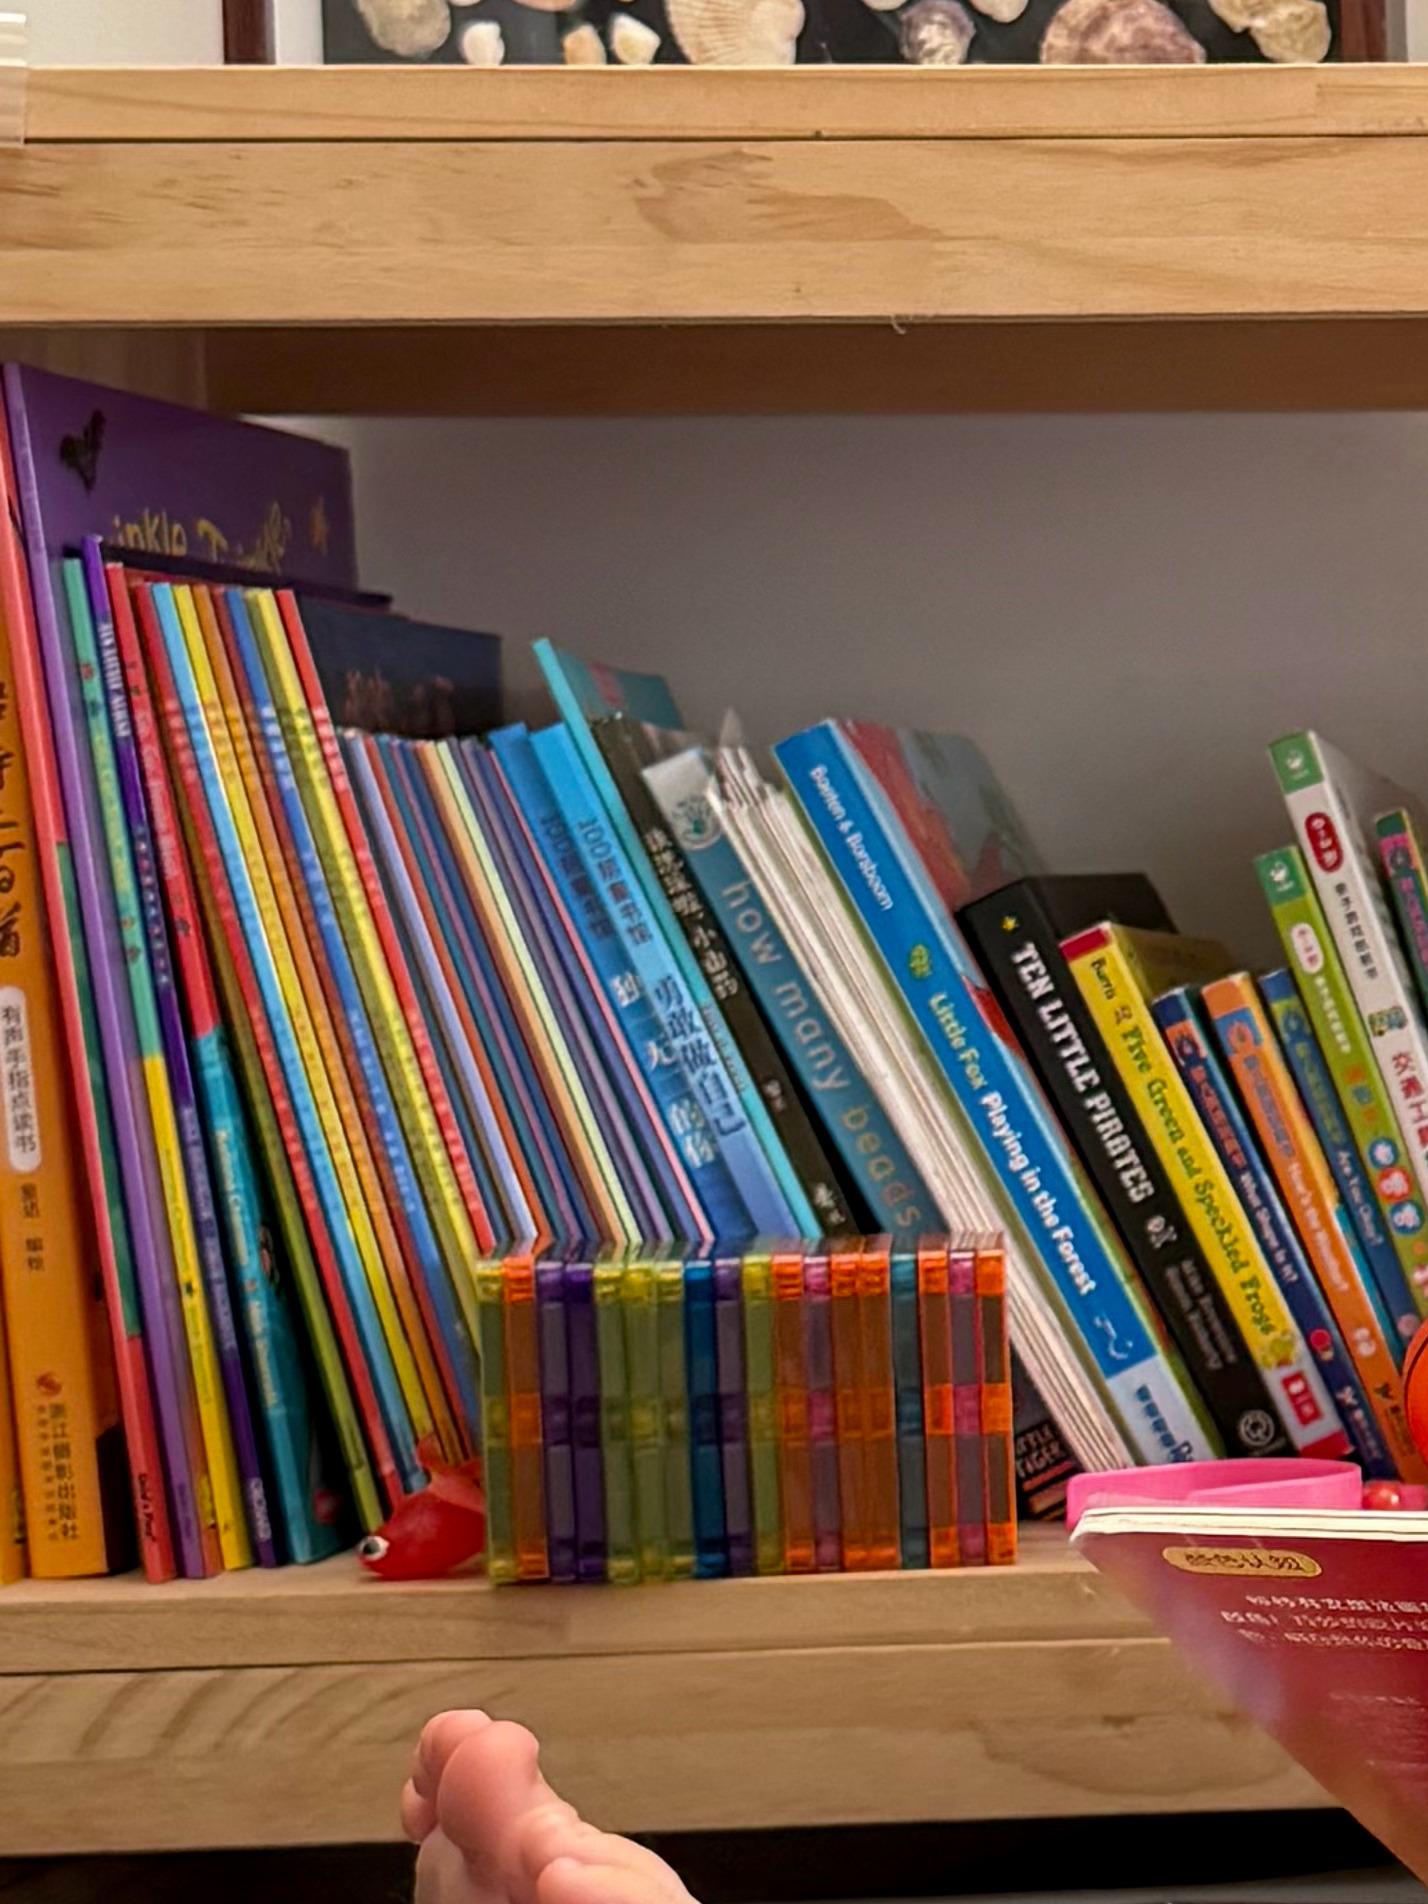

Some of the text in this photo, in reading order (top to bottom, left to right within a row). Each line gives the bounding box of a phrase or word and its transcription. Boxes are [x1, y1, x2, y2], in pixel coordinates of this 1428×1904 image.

[654, 973, 746, 1136] 勇敢做自己
[721, 879, 783, 966] how
[775, 980, 851, 1092] many
[841, 1102, 921, 1228] beads
[928, 992, 1096, 1296] Little Fox Playing in the Forest
[1011, 942, 1156, 1203] TEN LITTLE PIRATES
[1121, 1025, 1151, 1073] Five
[1147, 1078, 1185, 1145] Green
[1177, 1143, 1201, 1179] and
[1193, 1178, 1249, 1286] Speckled
[1241, 1272, 1275, 1336] Frogs
[1240, 1172, 1260, 1207] What
[1254, 1204, 1281, 1250] Shape
